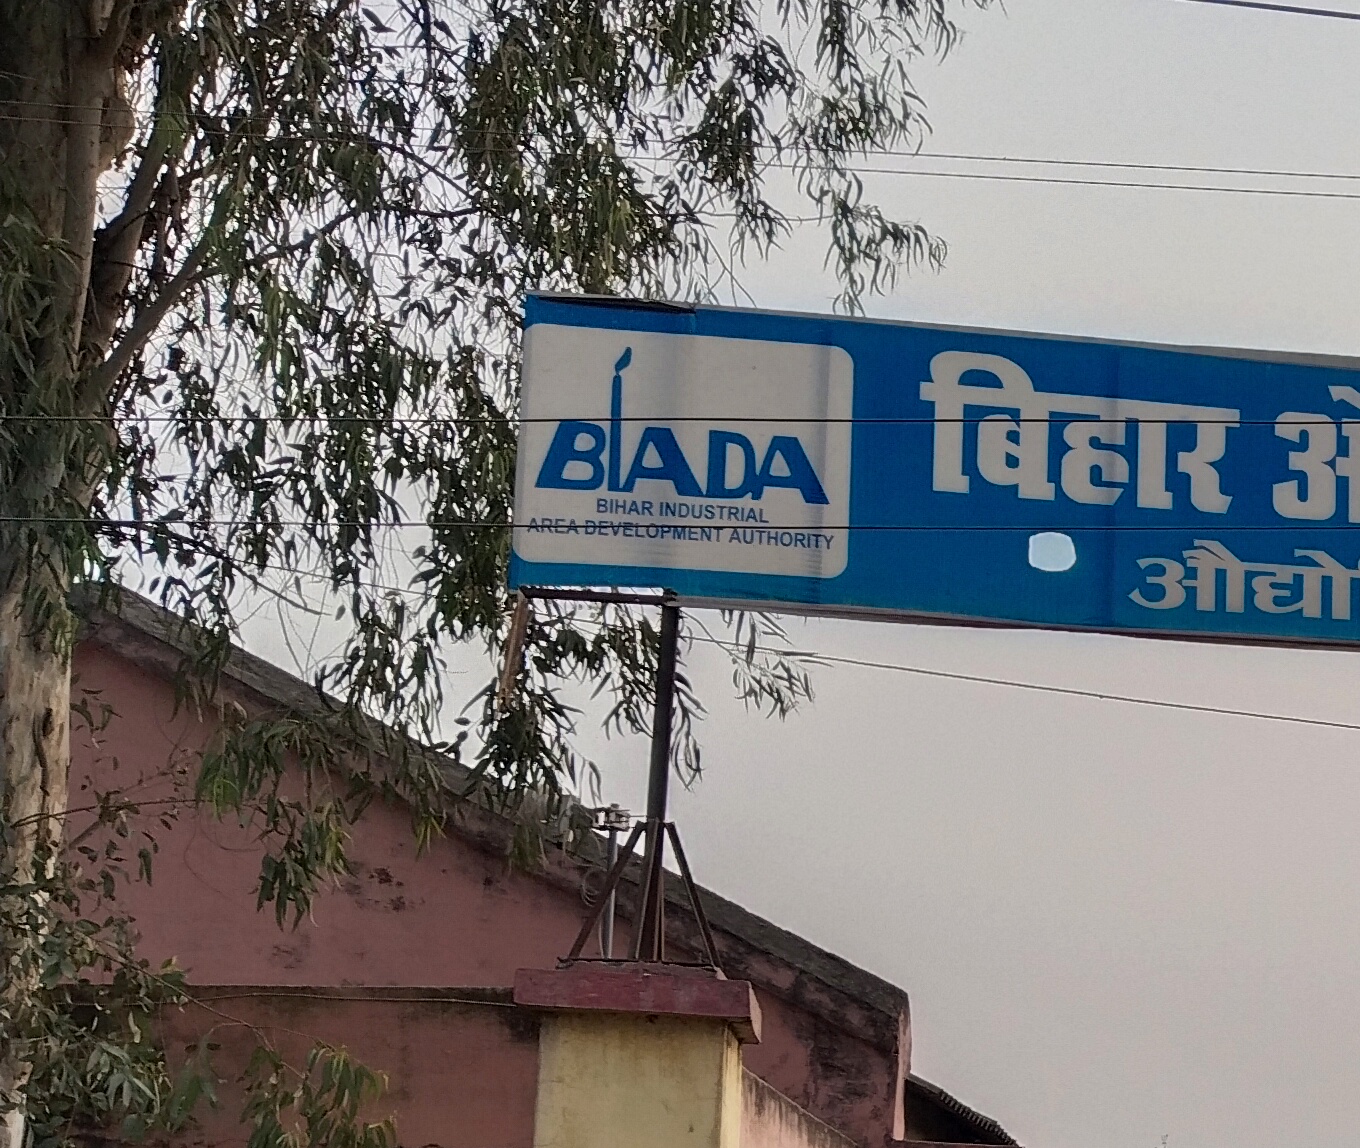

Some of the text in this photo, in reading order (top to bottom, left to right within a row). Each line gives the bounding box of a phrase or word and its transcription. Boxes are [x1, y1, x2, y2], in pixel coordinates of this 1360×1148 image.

[535, 372, 829, 505] BIADA
[920, 350, 1240, 515] बिहार
[527, 518, 834, 550] AREA DEVELOPMENT AUTHORITY
[596, 498, 769, 524] BIHAR INDUSTRIAL
